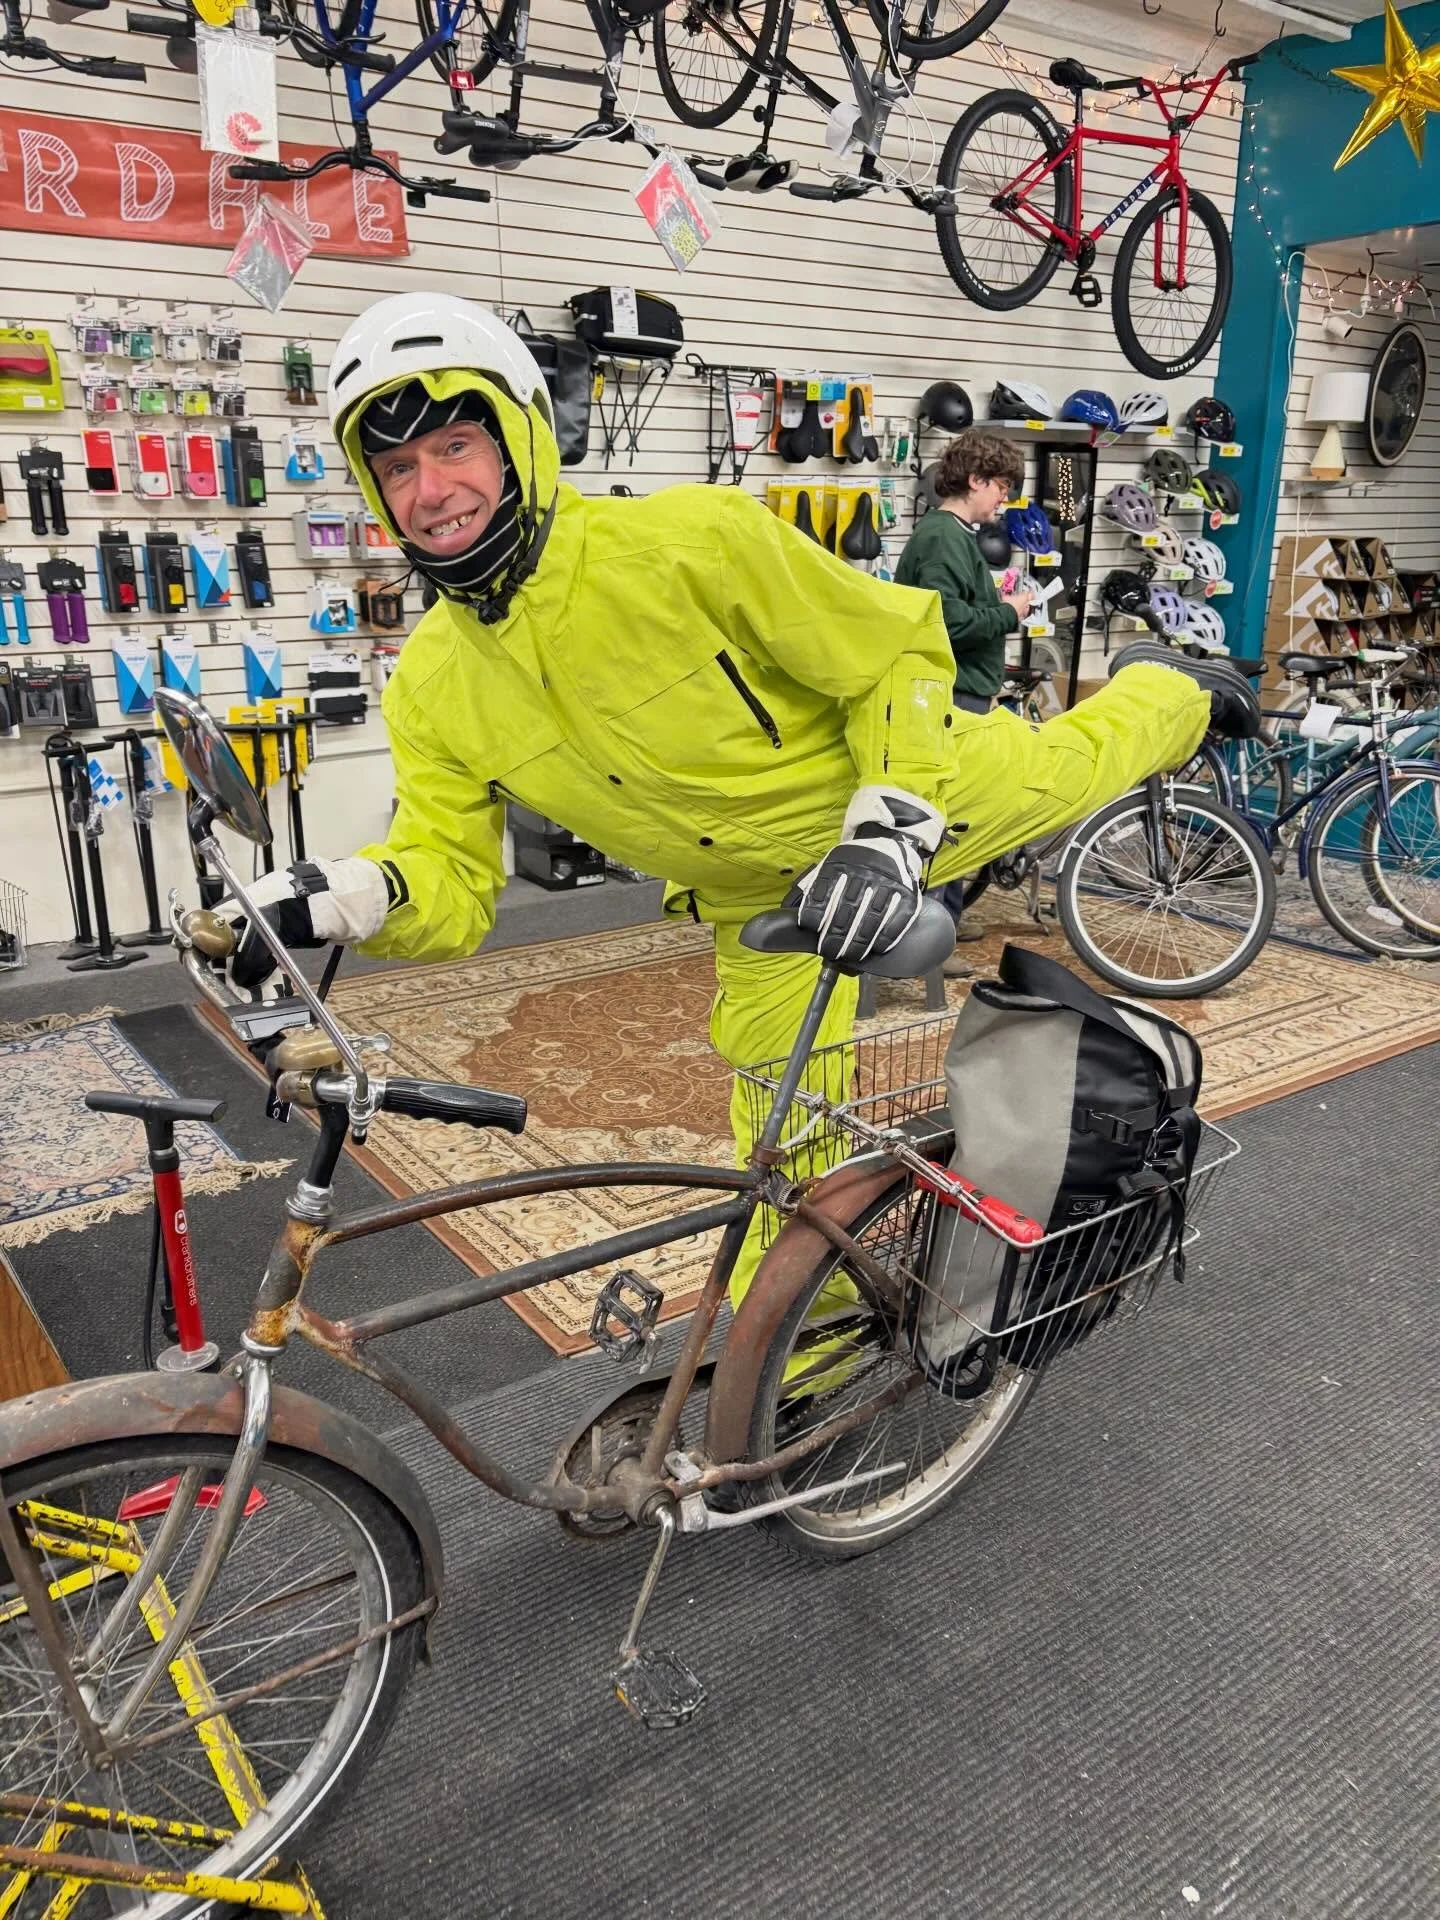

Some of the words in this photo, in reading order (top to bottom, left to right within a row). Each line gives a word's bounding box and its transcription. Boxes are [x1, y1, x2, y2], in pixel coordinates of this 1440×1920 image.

[0, 129, 393, 243] RDALE
[1104, 176, 1154, 228] FAIRDALE
[1166, 356, 1196, 373] MAXXIS
[180, 1236, 197, 1306] crankbrothers
